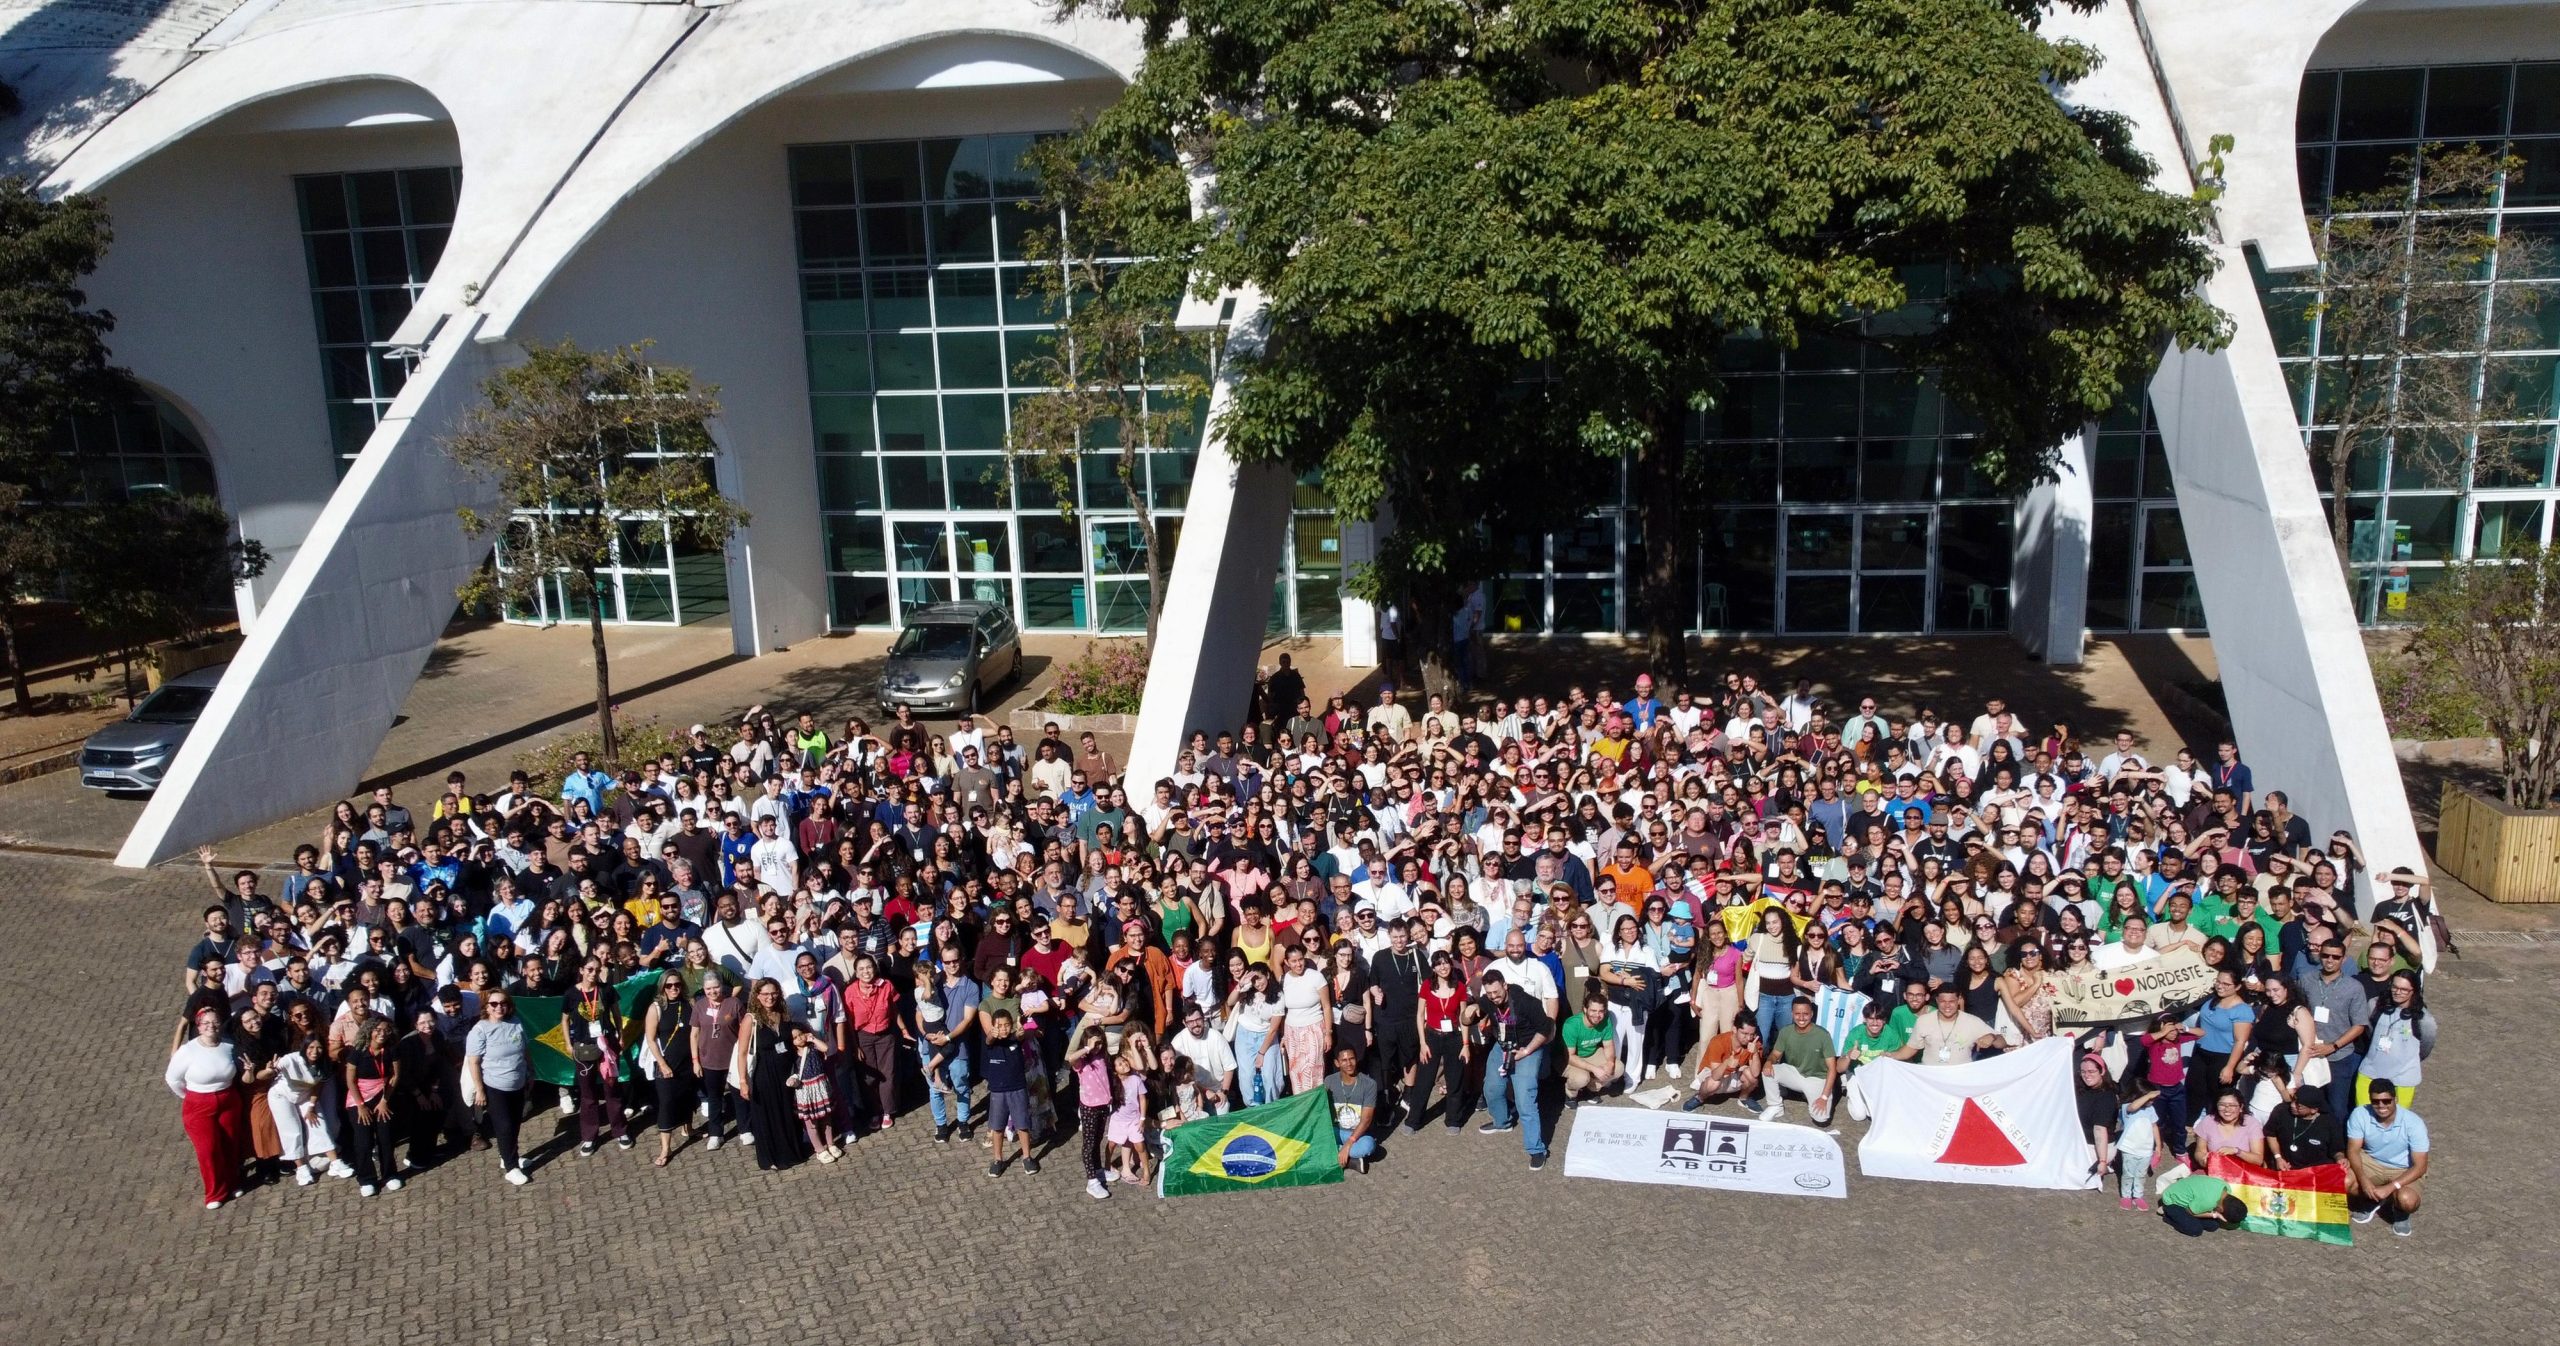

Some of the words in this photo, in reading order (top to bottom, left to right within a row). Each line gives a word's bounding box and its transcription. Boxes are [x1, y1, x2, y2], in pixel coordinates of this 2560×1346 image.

[2091, 983, 2114, 1000] EU
[2136, 964, 2204, 993] NORDESTE
[1835, 1007, 1845, 1018] 10
[2007, 1123, 2032, 1151] SERA
[1660, 1160, 1747, 1174] ABUB
[1951, 1166, 2014, 1175] TAMEN
